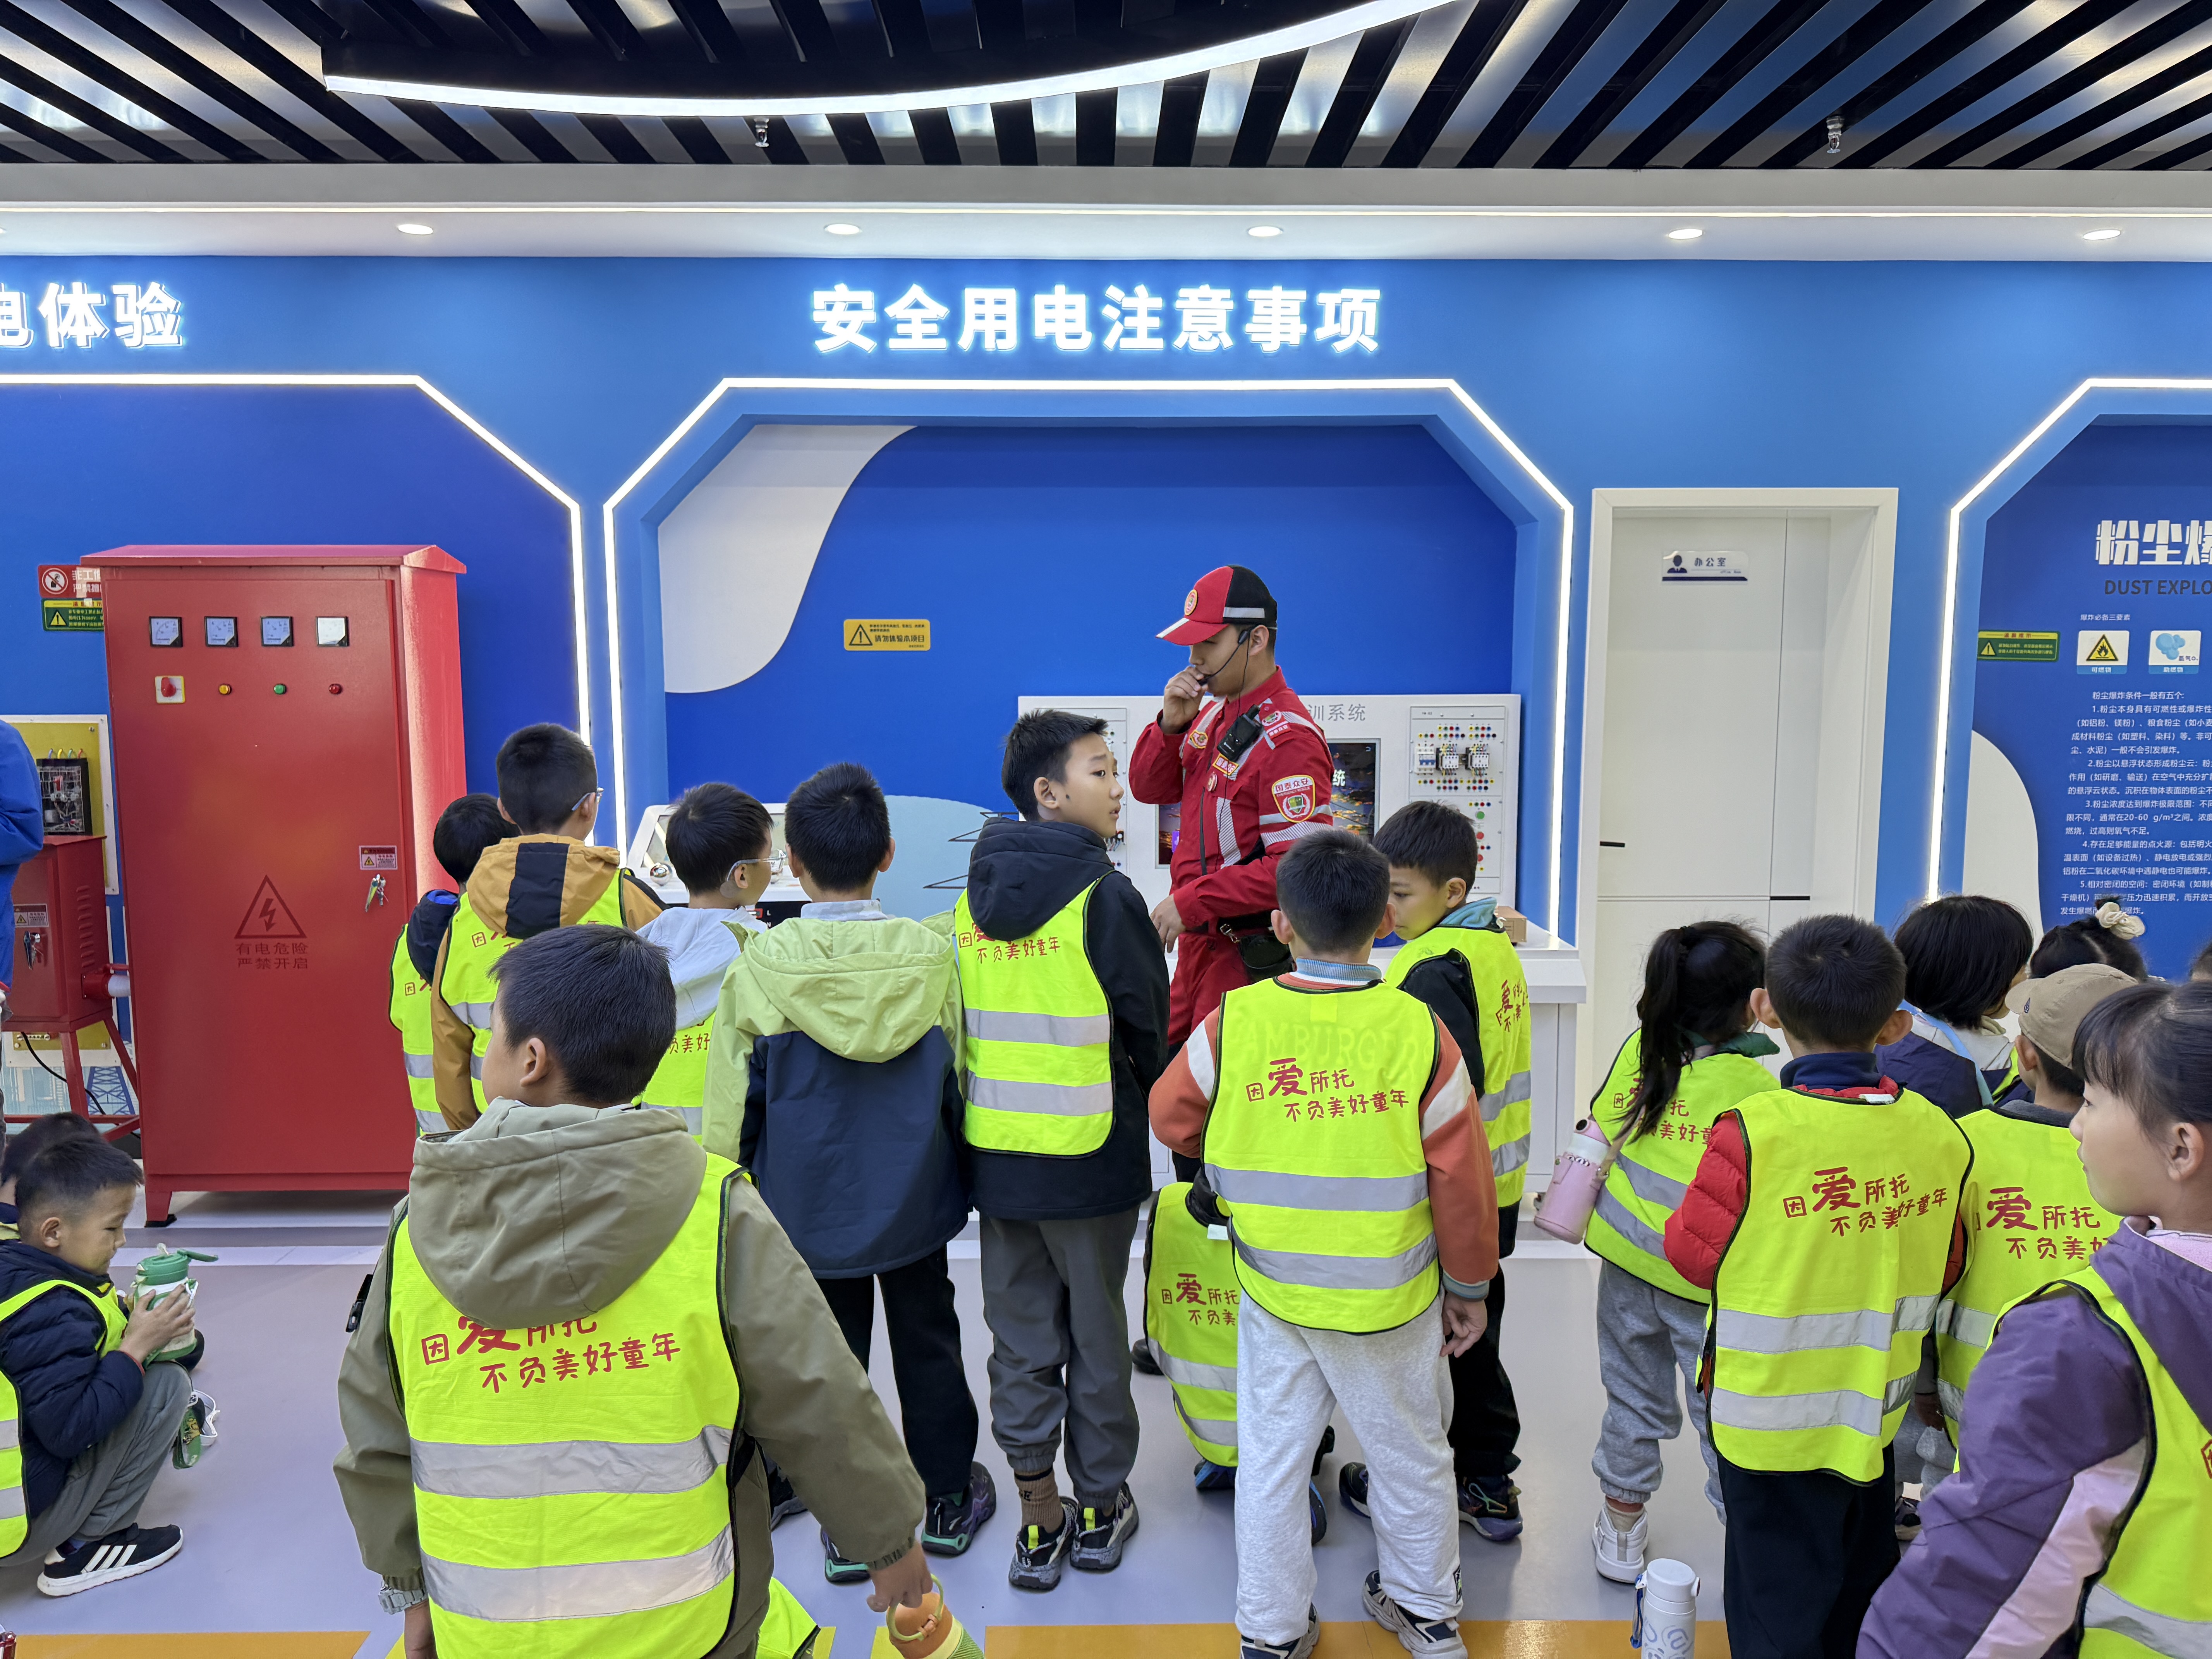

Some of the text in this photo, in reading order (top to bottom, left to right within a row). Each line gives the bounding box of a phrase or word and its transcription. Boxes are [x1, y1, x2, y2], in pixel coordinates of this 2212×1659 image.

[812, 283, 1381, 353] 安全用电注意事项
[1694, 558, 1726, 567] 办公室
[2104, 579, 2212, 595] DUST EXPLO
[875, 635, 925, 643] 请勿体验本项目
[2088, 759, 2212, 768] 2.粉尘以悬浮状态形成粉尘云：粉
[2080, 880, 2212, 888] 5.相对密闭的空间：密闭环境（如制
[235, 942, 308, 955] 有电危险
[237, 957, 308, 969] 严禁开启
[977, 936, 1060, 964] 不负美好童年
[1246, 1058, 1355, 1102] 因爱所托
[1284, 1089, 1409, 1122] 不负美好童年
[1783, 1166, 1910, 1218] 因爱所托
[1830, 1188, 1948, 1237] 不负美好童年
[1976, 1187, 2100, 1231] 爱所托
[1161, 1273, 1240, 1305] 因爱所托
[479, 1333, 681, 1393] 不负美好童年
